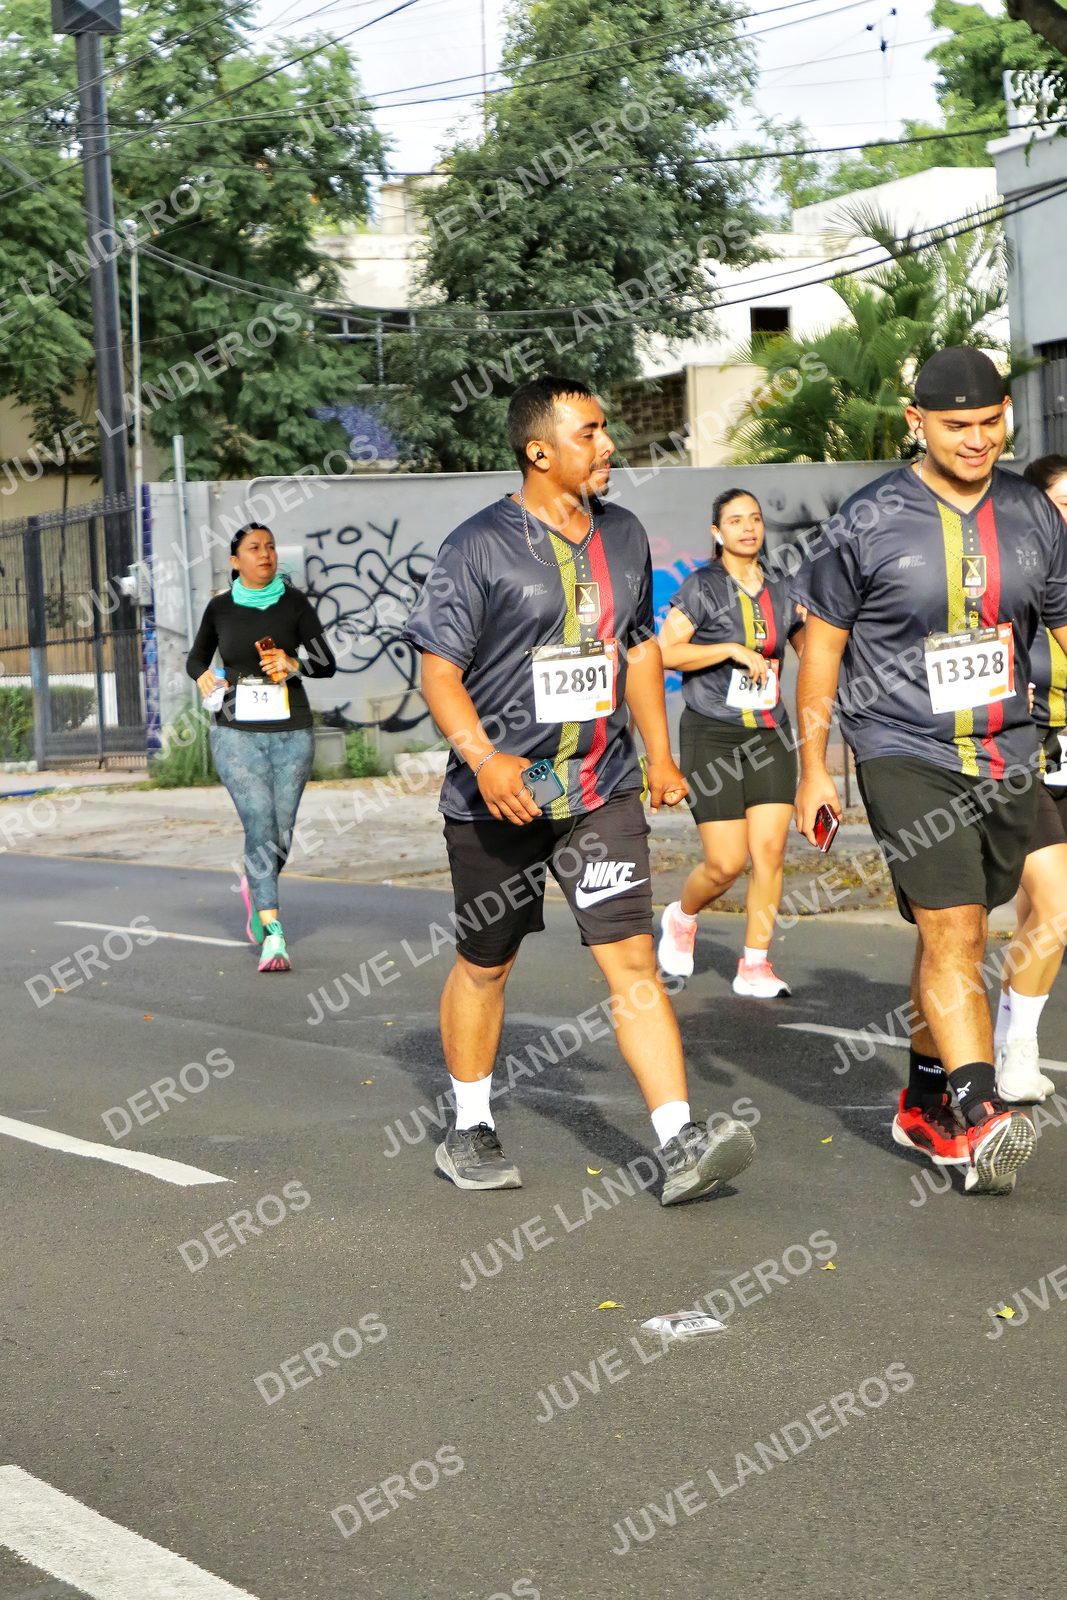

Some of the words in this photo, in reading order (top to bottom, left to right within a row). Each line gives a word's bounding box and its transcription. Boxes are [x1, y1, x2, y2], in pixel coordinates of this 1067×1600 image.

[306, 518, 399, 555] TOY
[540, 664, 607, 695] 12891
[931, 650, 1004, 684] 13328
[252, 690, 268, 704] 34
[580, 861, 636, 888] NIKE
